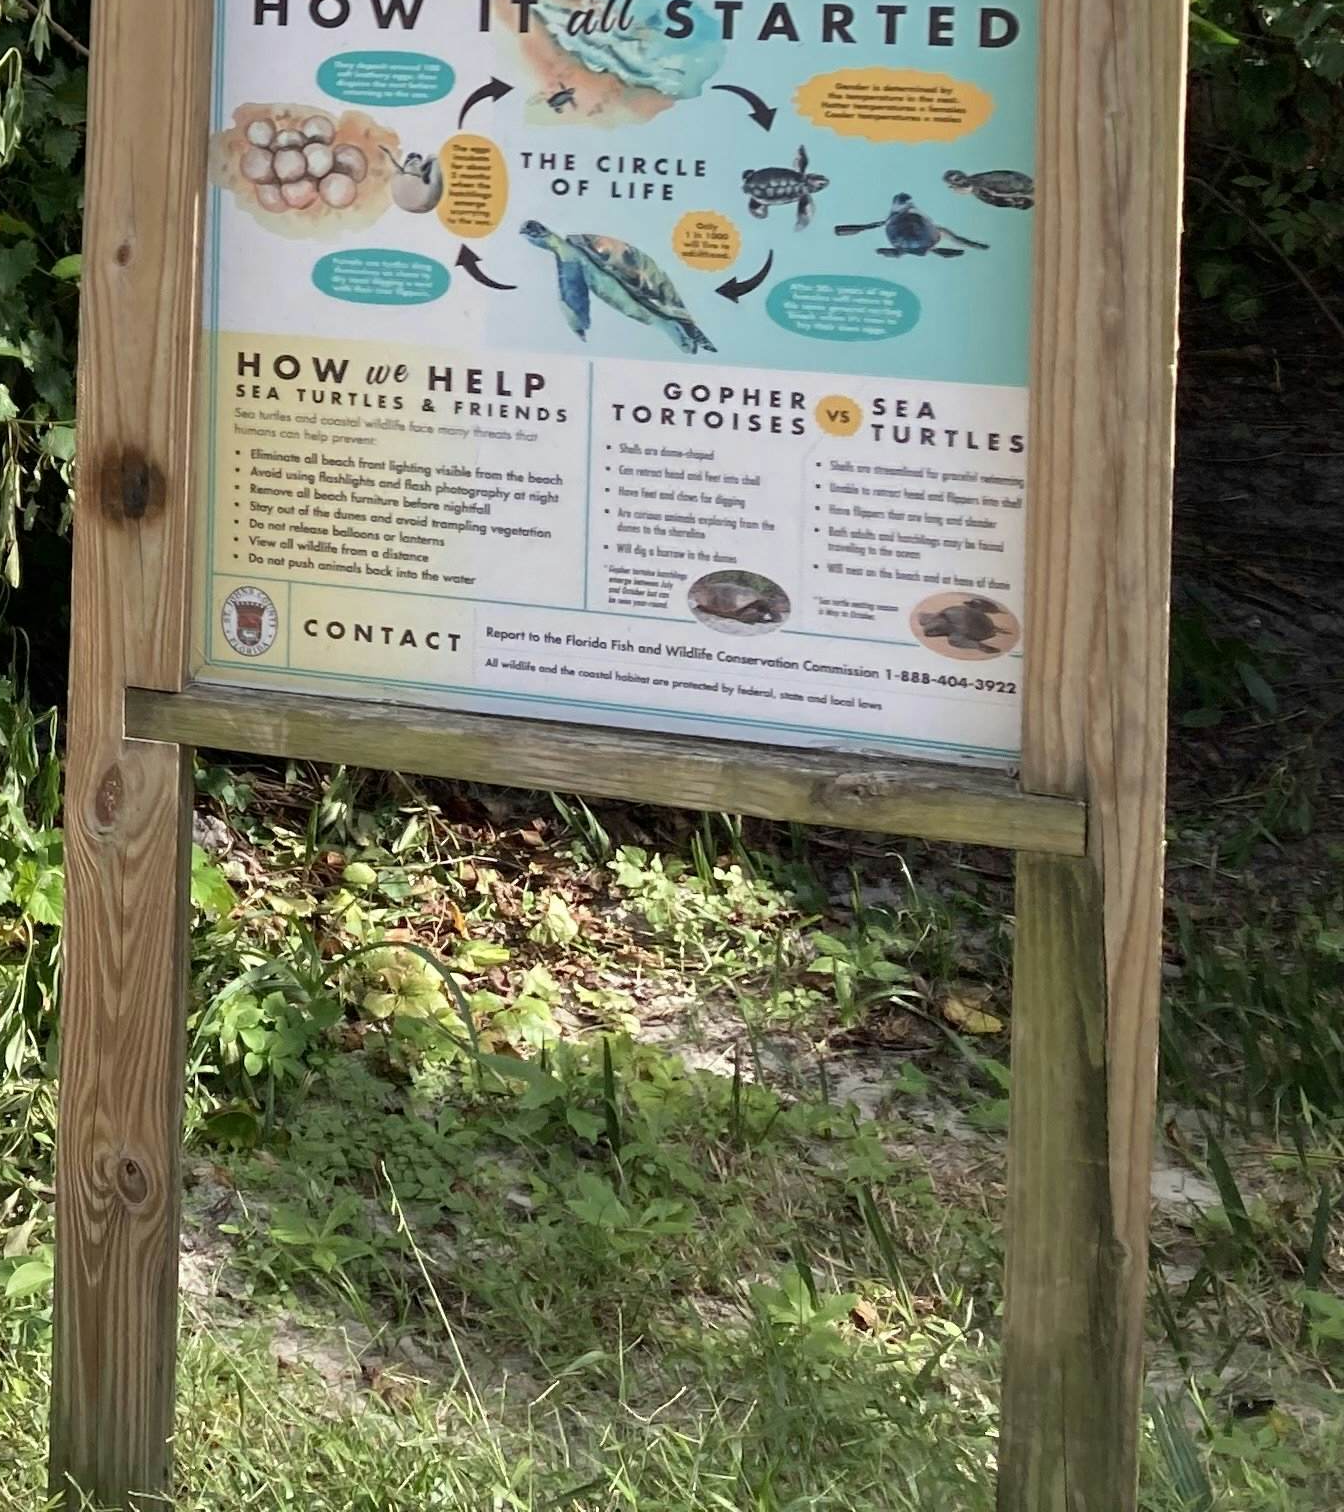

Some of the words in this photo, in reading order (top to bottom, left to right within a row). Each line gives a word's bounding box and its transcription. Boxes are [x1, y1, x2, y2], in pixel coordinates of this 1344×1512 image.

[519, 151, 575, 171] THE
[596, 155, 706, 177] CIRCLE
[551, 177, 589, 196] OF
[610, 180, 673, 201] LIFE
[237, 351, 349, 384] HOW
[365, 363, 409, 385] we
[428, 365, 545, 398] HELP
[235, 383, 280, 400] SEA
[295, 388, 403, 410] TURTLES
[421, 398, 436, 412] &
[453, 400, 567, 423] FRIENDS
[663, 382, 805, 410] GOPHER
[871, 397, 935, 420] SEA
[612, 403, 805, 435] TORTOISES
[825, 409, 850, 424] VS
[870, 423, 1024, 453] TURTLES
[248, 517, 265, 529] Do
[267, 522, 286, 531] not
[288, 521, 329, 535] release
[331, 524, 380, 541] balloons
[383, 533, 396, 542] or
[399, 530, 445, 547] lanterns
[249, 500, 274, 515] Stay
[276, 505, 295, 515] out
[297, 504, 310, 516] of
[312, 505, 330, 518] the
[332, 507, 367, 522] dunes
[369, 512, 392, 524] and
[395, 515, 428, 527] avoid
[431, 519, 487, 536] trampling
[489, 525, 552, 538] vegetation
[248, 552, 264, 564] Do
[266, 556, 285, 566] not
[287, 557, 315, 570] push
[317, 560, 362, 574] animals
[365, 562, 393, 577] back
[395, 566, 418, 579] into
[420, 568, 439, 582] the
[442, 575, 476, 585] water
[303, 618, 461, 652] CONTACT
[486, 625, 525, 642] Report
[528, 631, 540, 642] to
[543, 631, 562, 645] the
[565, 634, 607, 649] Florida
[610, 639, 634, 652] Fish
[637, 642, 662, 655] and
[664, 644, 713, 661] Wildlife
[716, 650, 799, 670] Conservation
[802, 659, 879, 679] Commission
[885, 668, 1017, 694] 1-888-404-3922
[484, 657, 499, 668] All
[500, 659, 536, 672] wildlife
[538, 663, 558, 674] and
[560, 665, 575, 676] the
[577, 670, 612, 680] coastal
[614, 670, 650, 684] habitat
[652, 678, 669, 686] are
[671, 680, 719, 692] protected
[720, 682, 735, 696] by
[736, 684, 776, 699] federal,
[779, 692, 804, 702] state
[806, 694, 827, 704] and
[829, 694, 855, 707] local
[857, 697, 882, 711] laws
